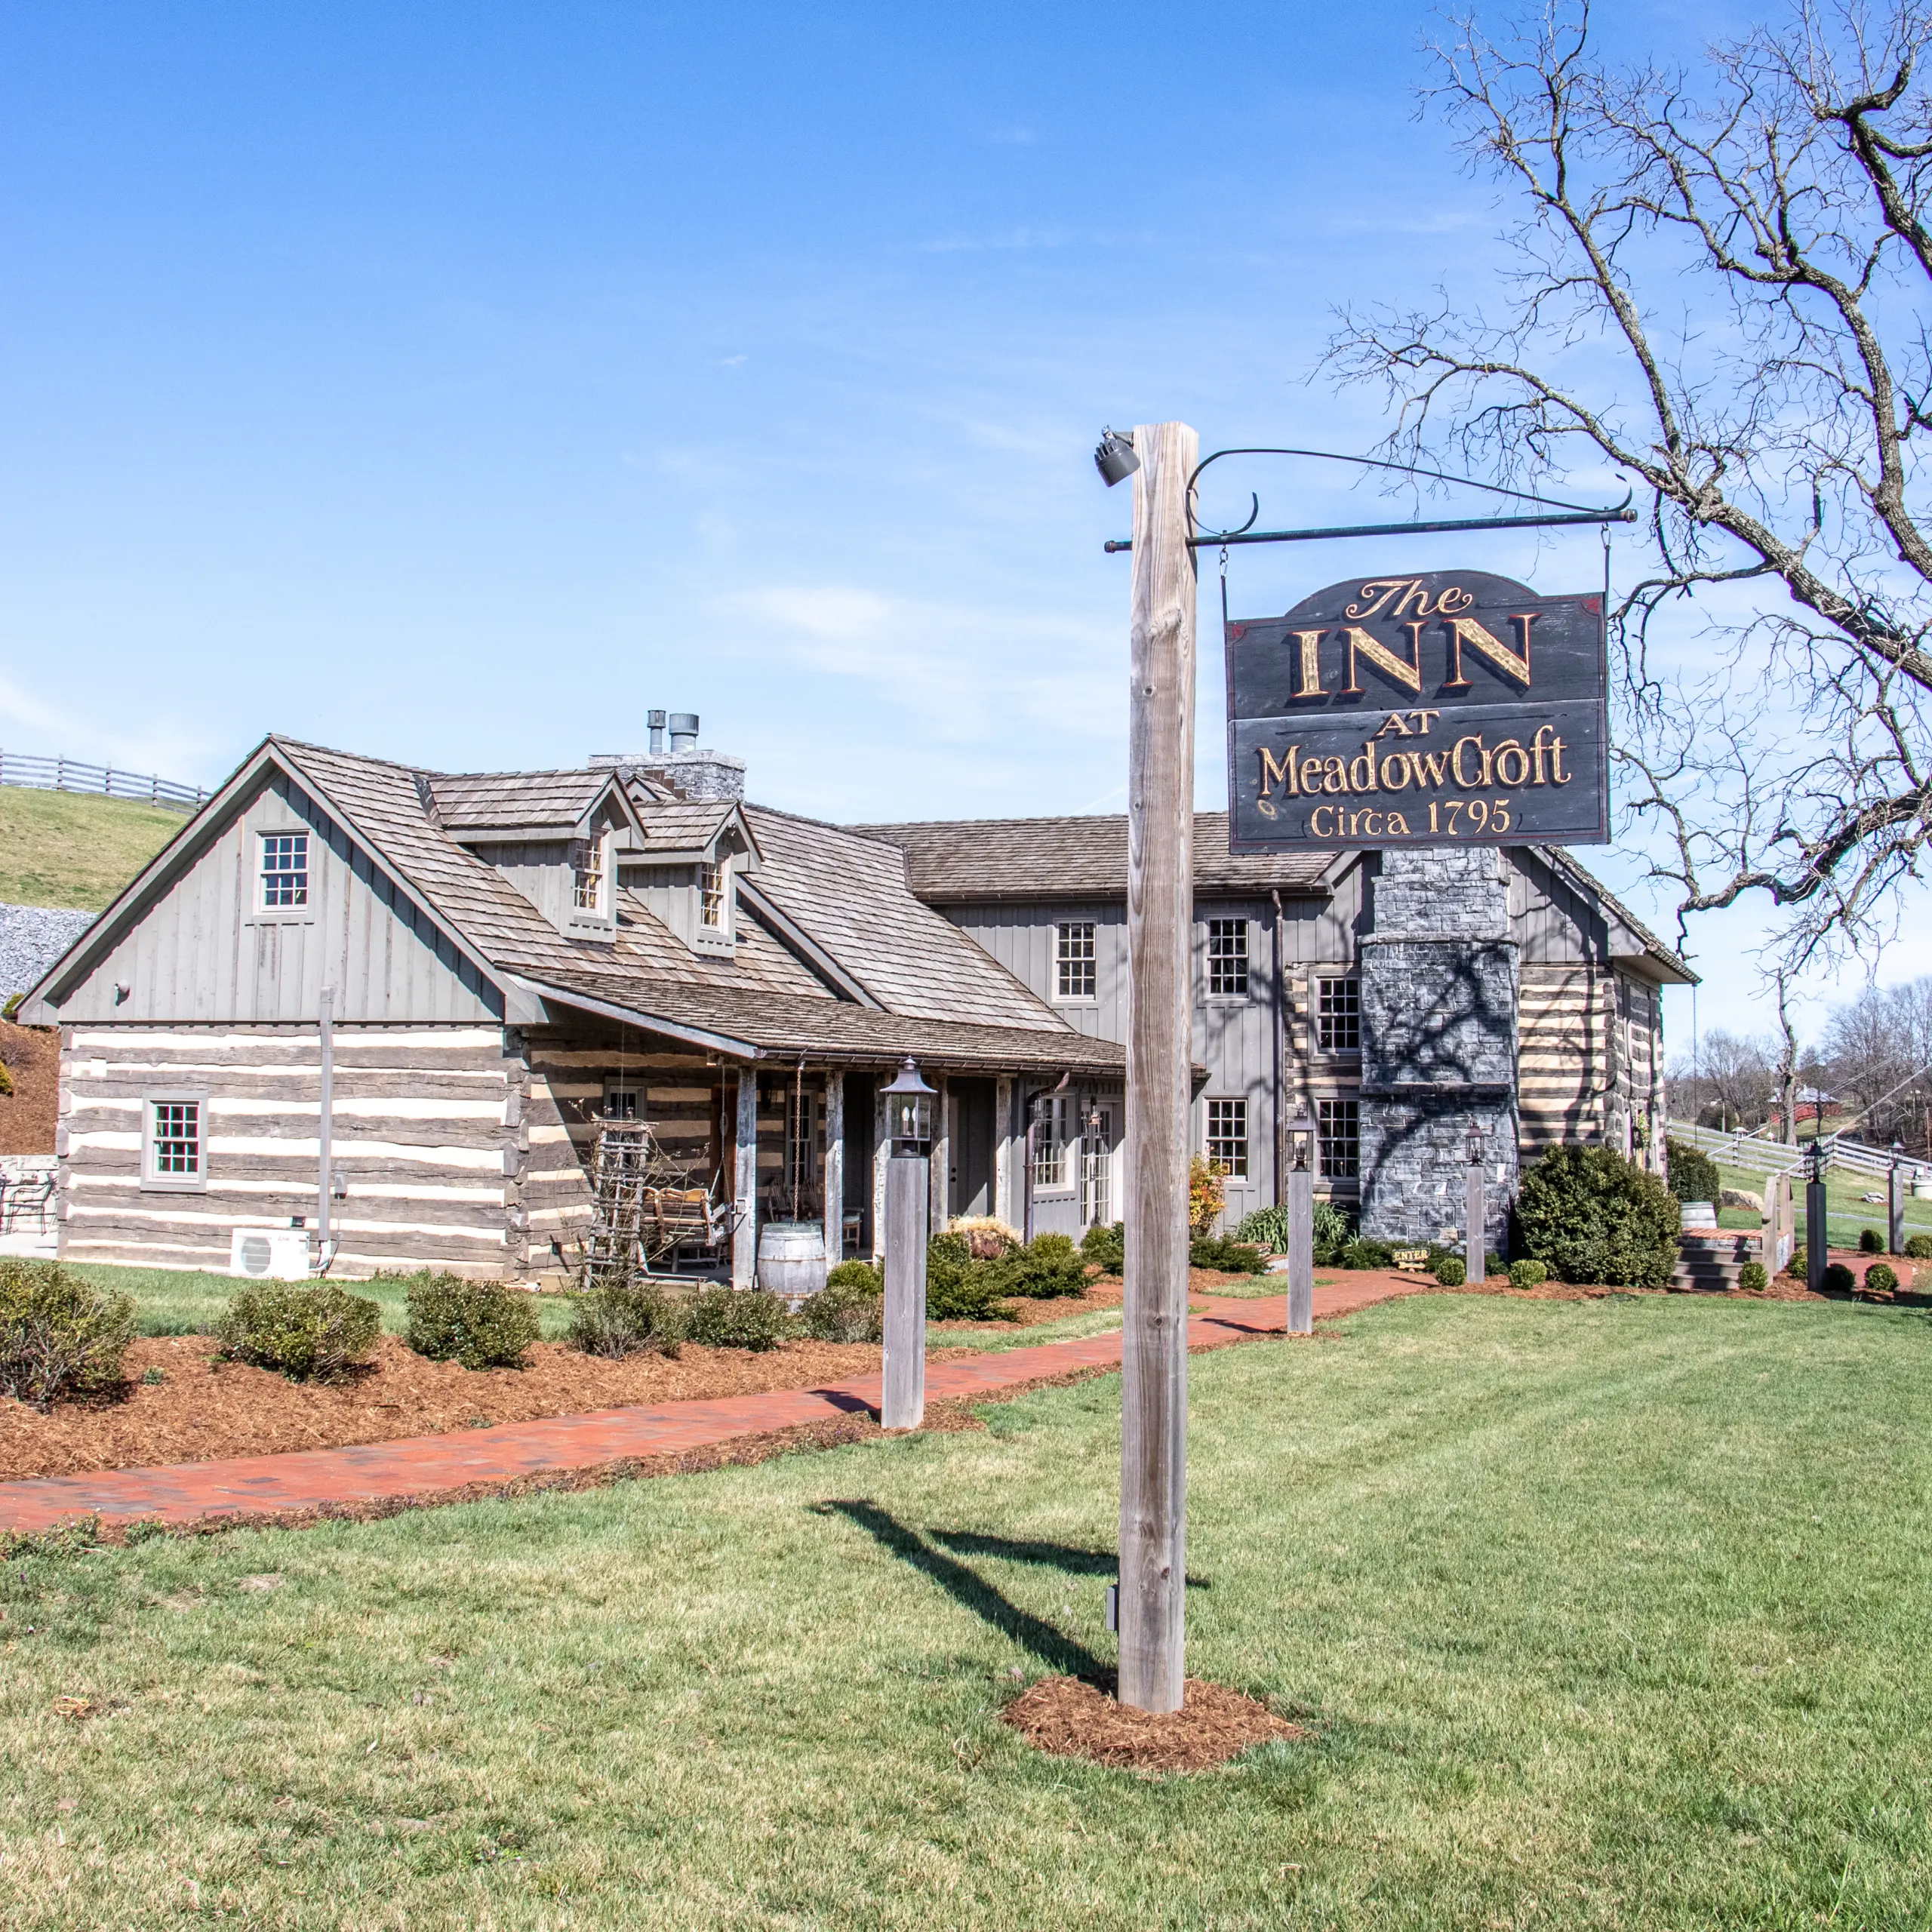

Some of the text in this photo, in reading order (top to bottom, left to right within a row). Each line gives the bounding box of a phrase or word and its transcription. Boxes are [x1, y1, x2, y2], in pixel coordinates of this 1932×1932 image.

[1345, 578, 1474, 620] The
[1288, 613, 1543, 699] INN
[1375, 709, 1441, 737] AT
[1257, 724, 1573, 796] MeadowCroft
[1310, 798, 1511, 838] Circa 1795
[1394, 1249, 1429, 1261] ENTER
